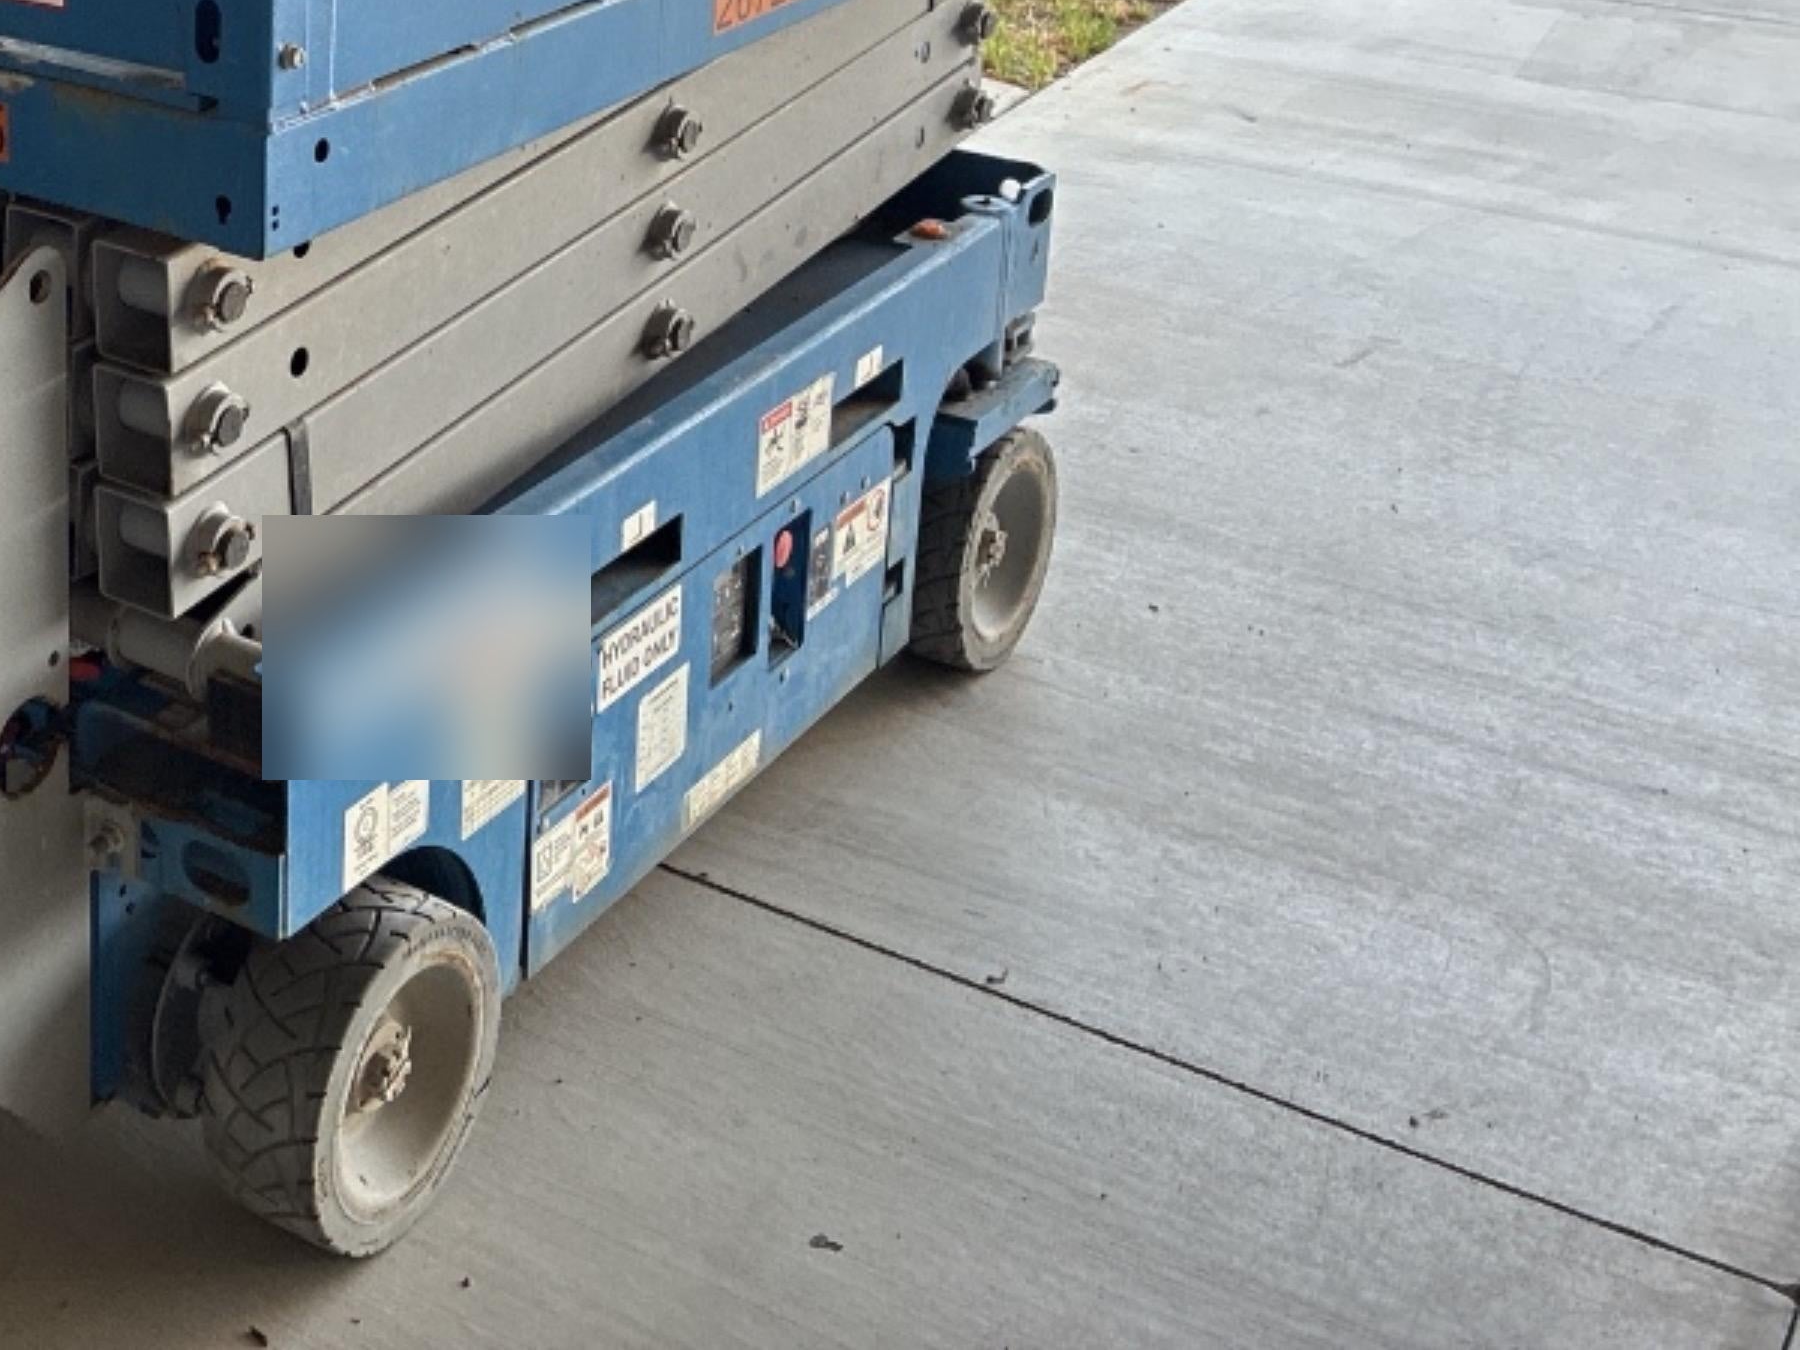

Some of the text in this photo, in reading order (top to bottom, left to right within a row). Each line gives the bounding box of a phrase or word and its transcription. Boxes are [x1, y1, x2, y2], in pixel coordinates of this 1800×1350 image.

[602, 596, 678, 669] HYDRAULIC
[602, 629, 675, 701] FLUID ONLY
